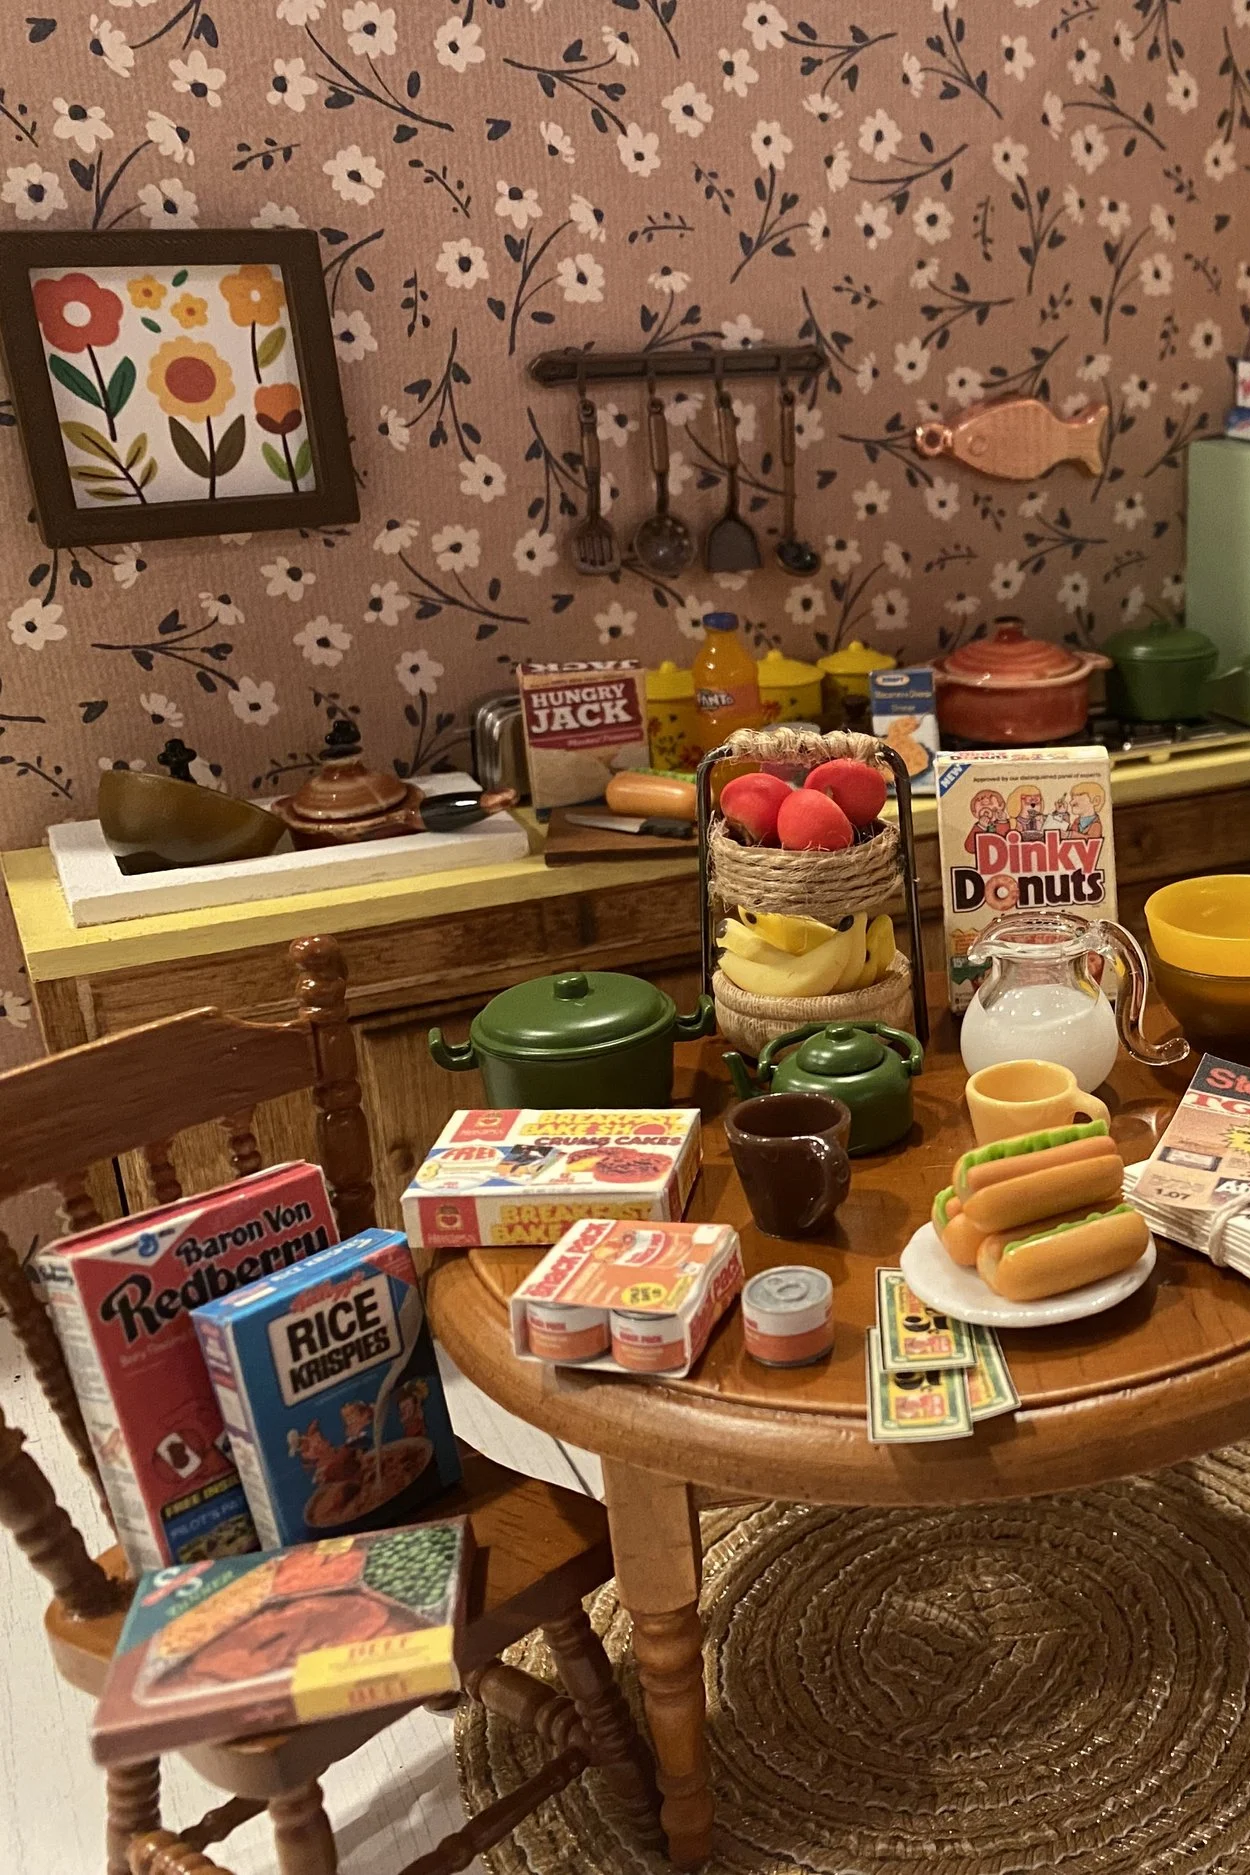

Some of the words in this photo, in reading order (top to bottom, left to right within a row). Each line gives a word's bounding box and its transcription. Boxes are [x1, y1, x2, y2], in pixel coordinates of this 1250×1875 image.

[531, 683, 625, 708] HUNGRY
[531, 699, 633, 733] JACK
[940, 763, 964, 789] NEW
[975, 830, 1103, 875] Dinky
[951, 866, 1105, 912] Donuts
[520, 1123, 590, 1136] BAKE
[538, 1113, 683, 1124] BREAKFAST
[534, 1136, 610, 1147] CRUMB
[614, 1136, 683, 1147] CAKES
[500, 1203, 652, 1222] BREAKFAST
[175, 1218, 264, 1267] Baron
[263, 1200, 313, 1234] Von
[100, 1225, 330, 1343] Redberry
[286, 1287, 382, 1363] RICE
[288, 1326, 391, 1394] KRISPIES
